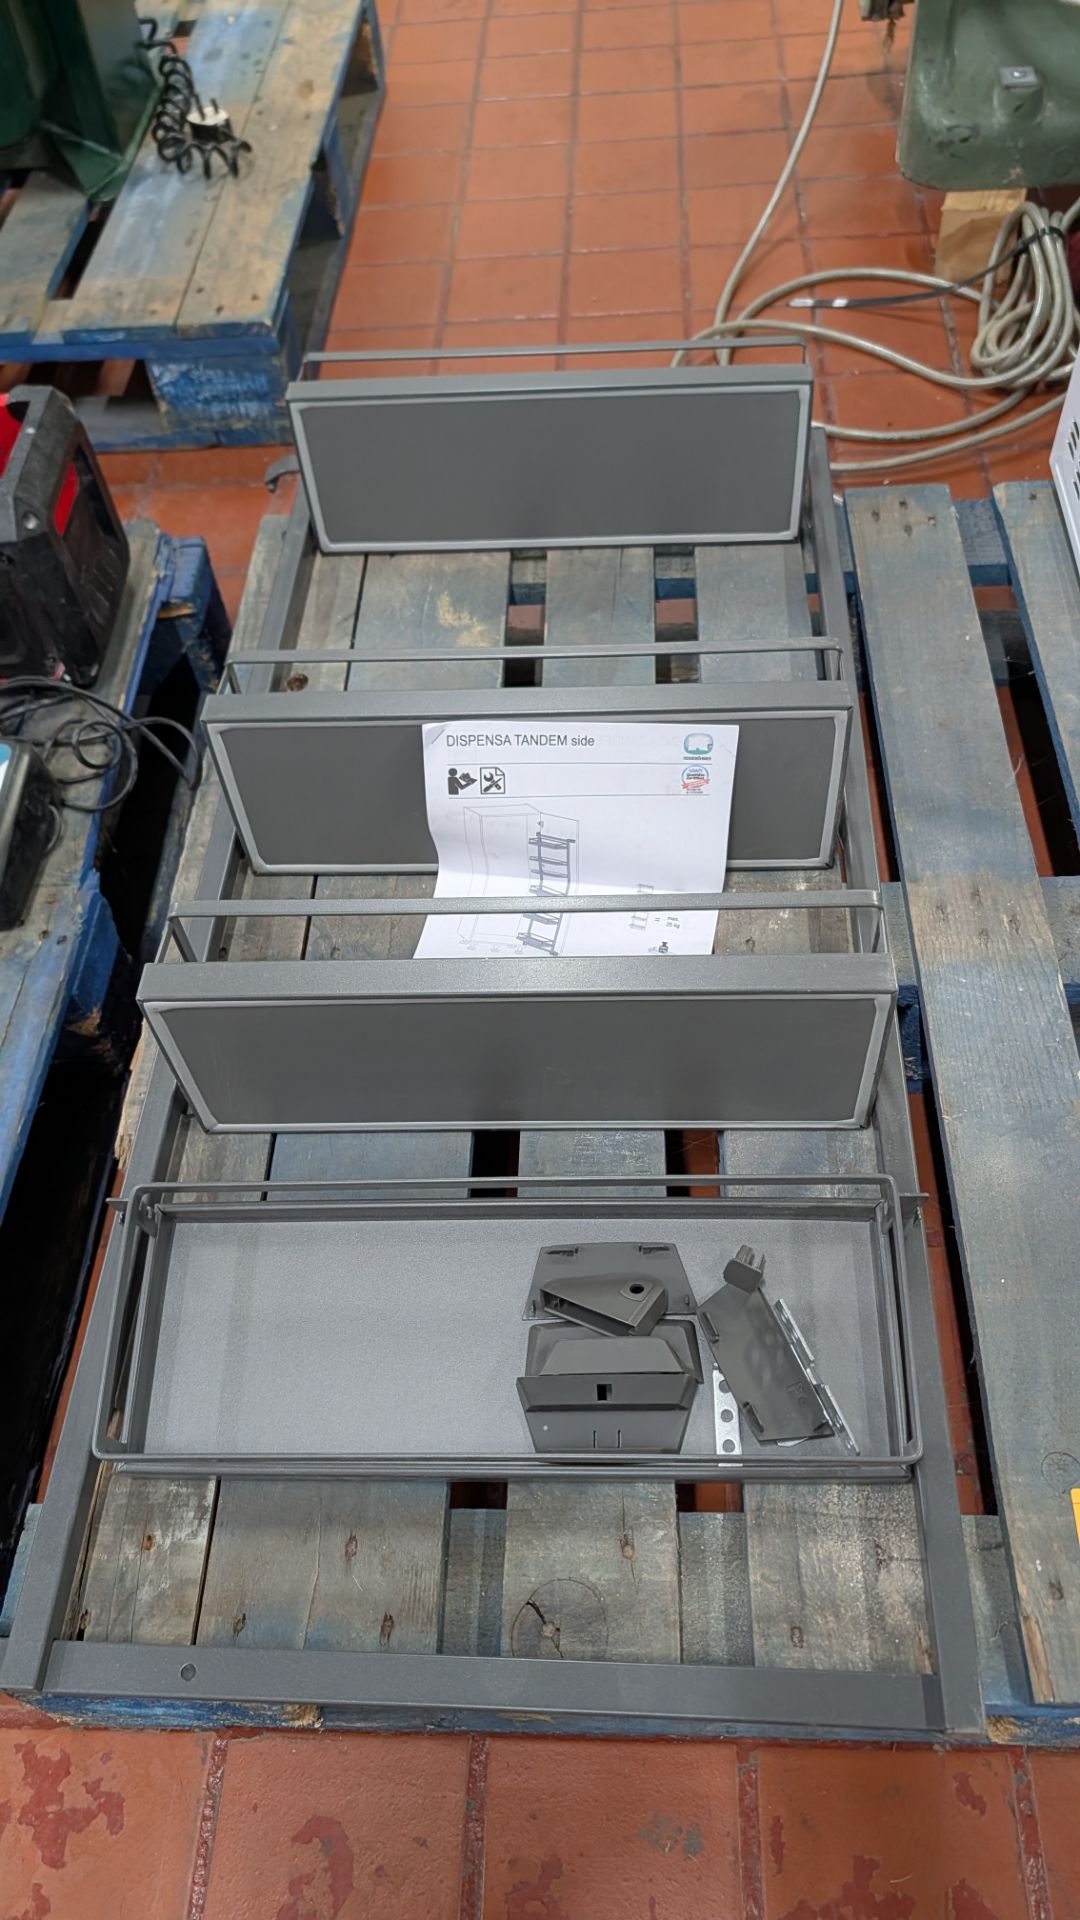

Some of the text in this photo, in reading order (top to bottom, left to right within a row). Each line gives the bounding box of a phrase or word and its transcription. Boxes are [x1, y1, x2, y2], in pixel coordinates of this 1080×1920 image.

[446, 734, 512, 747] DISPENSA
[514, 734, 567, 746] TANDEM
[570, 735, 595, 746] side
